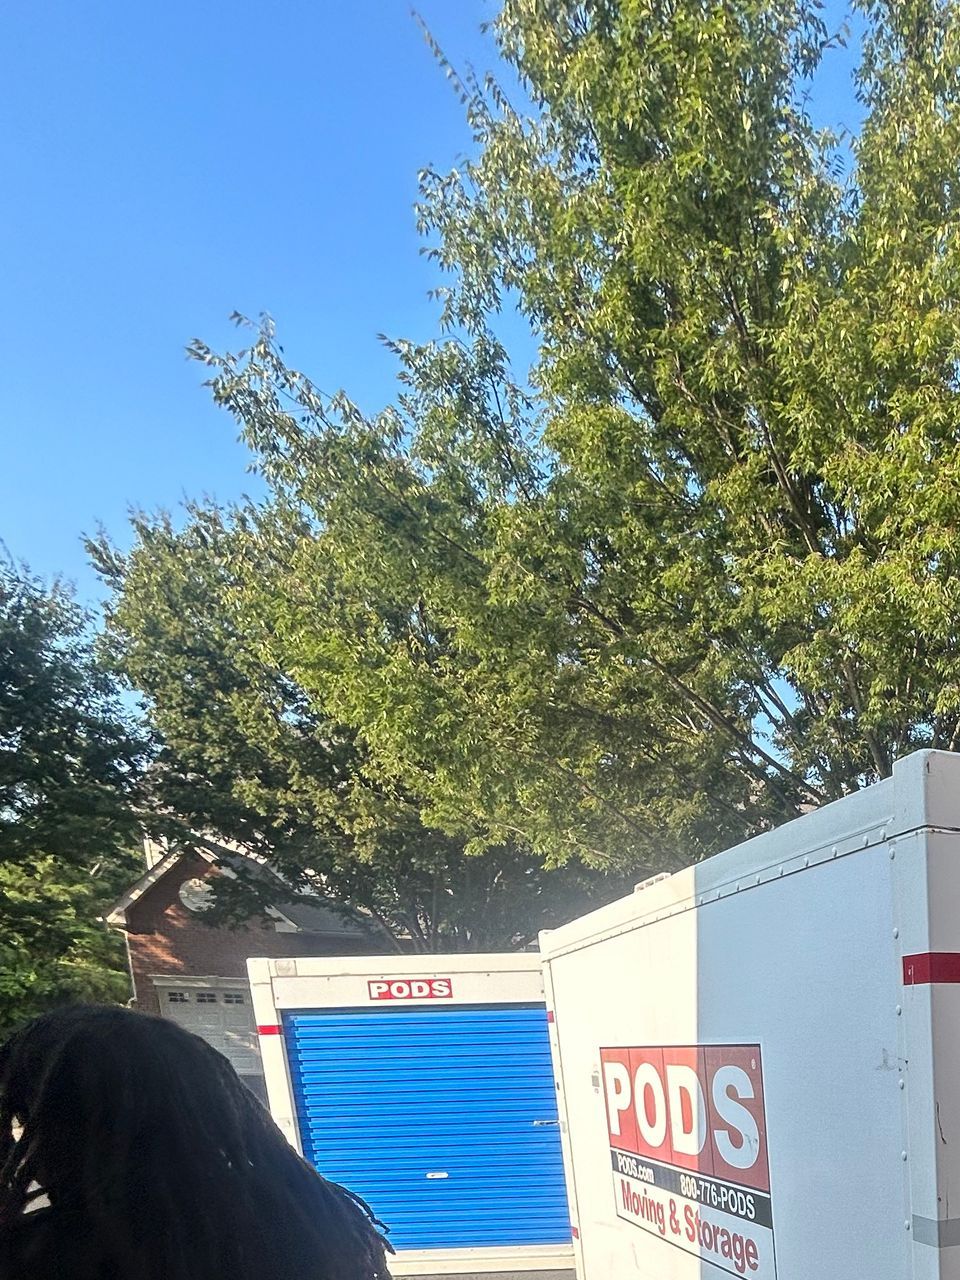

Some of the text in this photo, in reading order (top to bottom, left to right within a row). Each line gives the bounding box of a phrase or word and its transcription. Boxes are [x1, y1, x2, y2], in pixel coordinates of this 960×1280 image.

[369, 980, 451, 999] PODS
[603, 1061, 760, 1170] PODS
[616, 1152, 756, 1220] PODS.com 800-776-PODS
[620, 1178, 759, 1274] Moving & Storage
